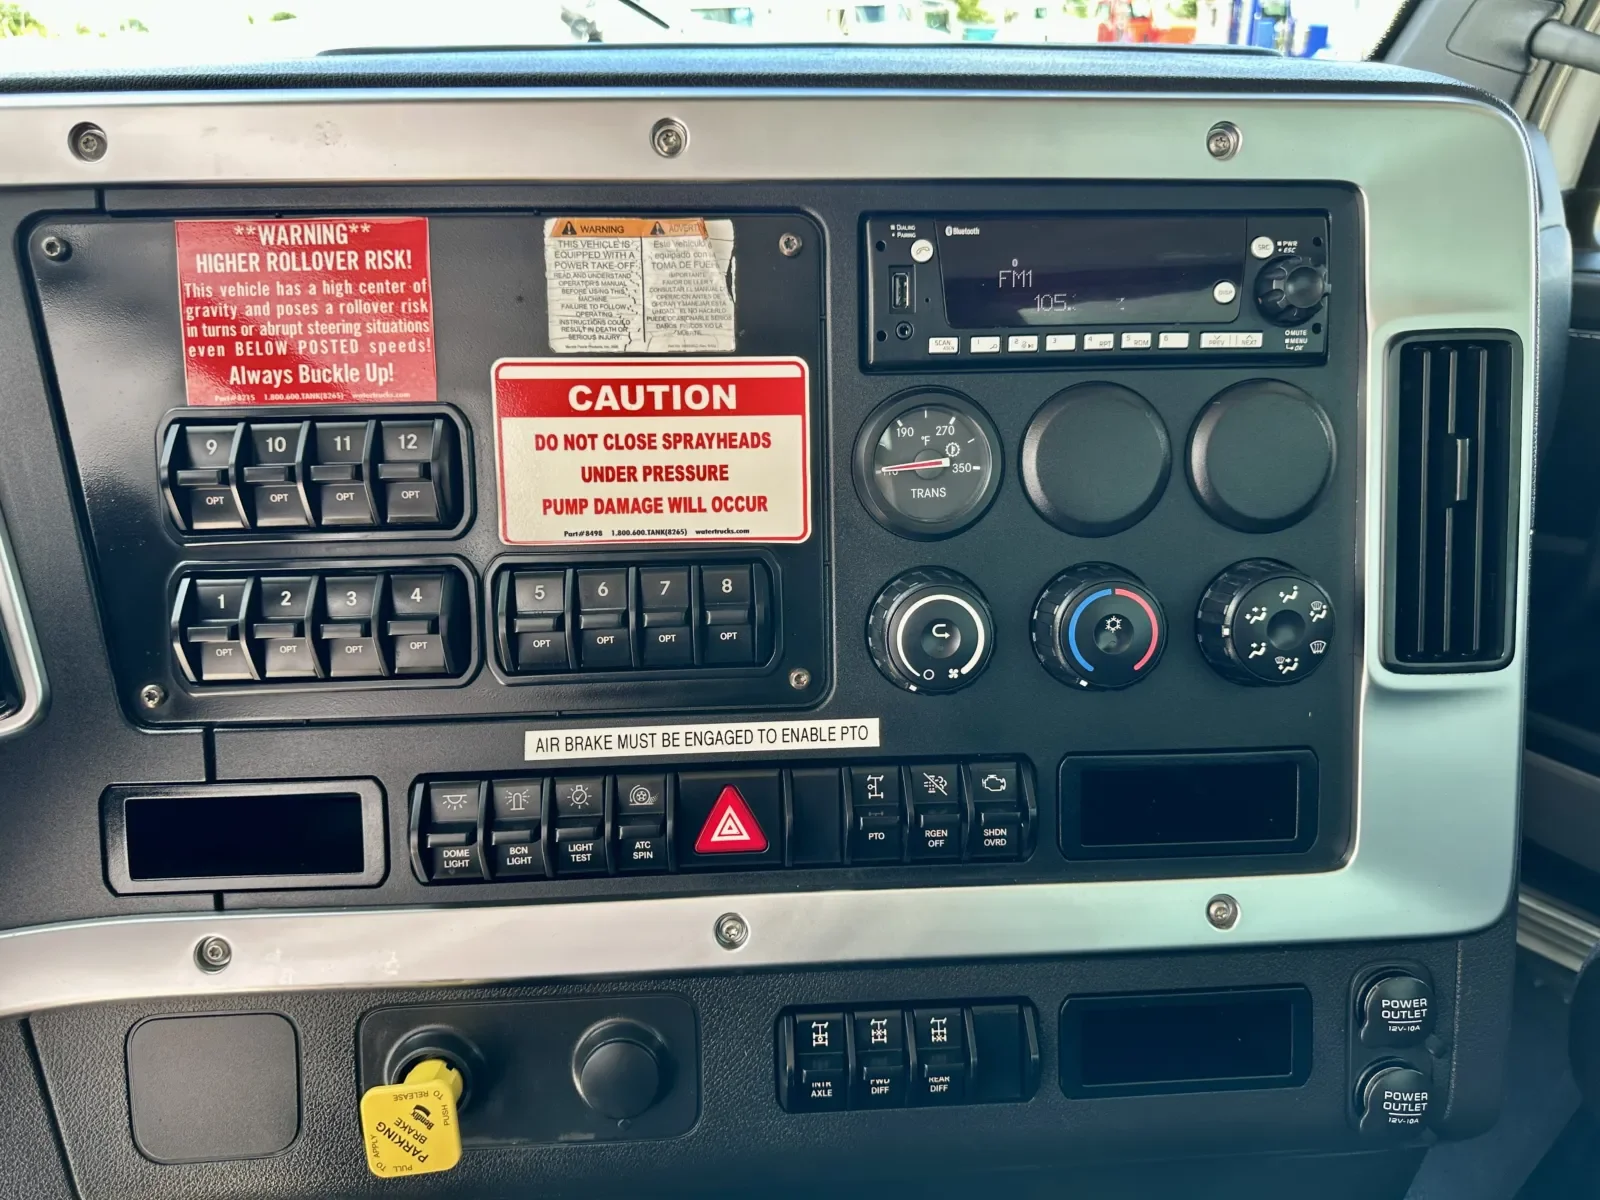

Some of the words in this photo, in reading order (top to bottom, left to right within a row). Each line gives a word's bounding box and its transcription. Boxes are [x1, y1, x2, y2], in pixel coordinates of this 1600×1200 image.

[580, 225, 625, 233] WARNING
[953, 226, 980, 235] Bluetooth
[558, 240, 578, 248] THIS
[580, 240, 619, 248] VEHICLE
[621, 240, 630, 248] IS
[554, 251, 600, 259] EQUIPPED
[603, 251, 627, 259] WITH
[629, 251, 635, 259] A
[654, 251, 691, 260] equipado
[196, 252, 260, 273] HIGHER
[267, 250, 359, 272] ROLLOVER
[366, 249, 412, 270] RISK!
[554, 261, 589, 269] POWER
[591, 261, 635, 269] TAKE-OFF
[651, 261, 677, 270] TOMA
[679, 261, 692, 269] DE
[999, 269, 1032, 288] FM1
[184, 282, 213, 298] This
[220, 281, 270, 297] vehicle
[276, 281, 300, 296] has
[309, 284, 316, 296] a
[322, 280, 352, 297] high
[359, 279, 405, 294] center
[413, 278, 427, 293] of
[186, 302, 237, 320] gravity
[245, 301, 270, 316] and
[276, 302, 318, 318] poses
[325, 302, 333, 315] a
[339, 299, 394, 314] rollover
[401, 298, 428, 314] risk
[186, 323, 198, 338] in
[202, 322, 237, 337] turns
[240, 322, 253, 336] or
[260, 321, 303, 339] abrupt
[307, 320, 361, 338] steering
[366, 318, 429, 334] situations
[188, 343, 225, 357] even
[235, 340, 287, 356] BELOW
[298, 338, 359, 355] POSTED
[369, 337, 431, 356] speeds!
[229, 365, 293, 389] Always
[299, 363, 359, 385] Buckle
[366, 362, 394, 386] Up!
[264, 392, 344, 401] 1.800.600.TANK(8265)
[352, 391, 410, 399] watertrucks.com
[568, 383, 737, 411] CAUTION
[896, 427, 914, 437] 190
[936, 426, 955, 436] 270
[266, 436, 287, 452] 10
[334, 435, 351, 451] 11
[398, 434, 418, 450] 12
[535, 434, 558, 451] DO
[564, 433, 598, 451] NOT
[603, 432, 657, 450] CLOSE
[662, 431, 772, 449] SPRAYHEADS
[206, 440, 217, 455] 9
[952, 463, 972, 473] 350
[581, 465, 638, 483] UNDER
[642, 464, 729, 482] PRESSURE
[270, 493, 288, 502] OPT
[336, 492, 354, 501] OPT
[401, 490, 420, 499] OPT
[911, 487, 947, 498] TRANS
[206, 496, 224, 505] OPT
[542, 498, 589, 515] PUMP
[594, 497, 664, 514] DAMAGE
[668, 496, 707, 513] WILL
[711, 495, 768, 513] OCCUR
[611, 528, 687, 537] 1.800.600.TANK(8265)
[695, 527, 750, 535] watertrucks.com
[598, 582, 609, 597] 6
[660, 581, 671, 596] 7
[722, 579, 733, 593] 8
[410, 588, 422, 602] 4
[534, 585, 545, 600] 5
[217, 594, 225, 608] 1
[281, 591, 292, 606] 2
[346, 591, 357, 606] 3
[597, 636, 614, 645] OPT
[658, 634, 676, 643] OPT
[720, 632, 737, 641] OPT
[410, 641, 428, 650] OPT
[533, 640, 551, 648] OPT
[216, 649, 233, 657] OPT
[280, 645, 297, 654] OPT
[345, 645, 363, 654] OPT
[536, 737, 560, 753] AIR
[565, 734, 612, 752] BRAKE
[617, 732, 657, 750] MUST
[661, 732, 680, 747] BE
[684, 728, 753, 747] ENGAGED
[757, 727, 777, 744] TO
[782, 725, 836, 743] ENABLE
[840, 724, 868, 741] PTO
[868, 832, 885, 840] PTO
[925, 829, 948, 837] RGEN
[983, 828, 1007, 836] SHDN
[634, 841, 651, 849] ATC
[928, 839, 945, 847] OFF
[983, 838, 1007, 846] OVRD
[509, 846, 529, 855] BCN
[568, 843, 593, 852] LIGHT
[443, 849, 470, 858] DOME
[571, 853, 592, 862] TEST
[633, 851, 653, 860] SPIN
[444, 859, 470, 868] LIGHT
[507, 856, 532, 865] LIGHT
[1381, 998, 1427, 1009] POWER
[1381, 1009, 1427, 1019] OUTLET
[811, 1089, 832, 1097] AXLE
[871, 1086, 889, 1094] DIFF
[930, 1084, 948, 1093] DIFF
[393, 1090, 429, 1101] RELEASE
[433, 1090, 444, 1101] TO
[1384, 1091, 1428, 1102] POWER
[1383, 1101, 1428, 1112] OUTLET
[410, 1109, 435, 1131] Bendix
[442, 1104, 450, 1126] PUSH
[393, 1117, 428, 1145] BRAKE
[370, 1134, 380, 1158] APPLY
[376, 1121, 429, 1163] PARKING
[376, 1161, 387, 1172] TO
[393, 1164, 413, 1172] PULL
